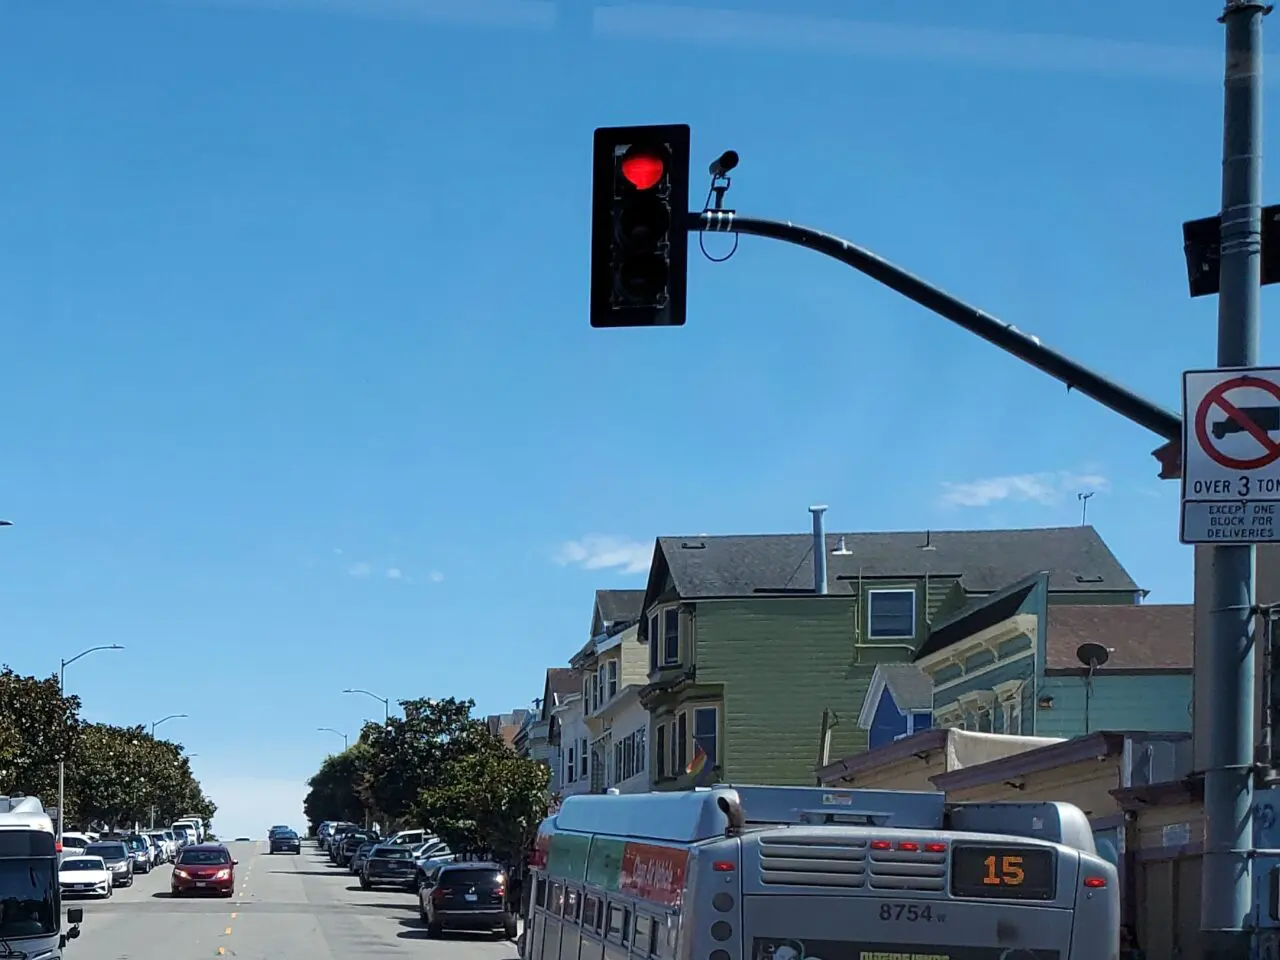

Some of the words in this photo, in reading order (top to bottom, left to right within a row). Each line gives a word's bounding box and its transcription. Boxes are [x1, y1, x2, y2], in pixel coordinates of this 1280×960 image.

[1193, 479, 1231, 494] OVER
[1237, 475, 1250, 497] 3
[1208, 504, 1246, 515] EXCEPT
[1253, 504, 1276, 514] ONE
[1210, 516, 1245, 526] BLOCK
[1252, 516, 1273, 526] FOR
[1207, 528, 1275, 538] DELIVERIES
[982, 855, 1025, 886] 15
[879, 903, 933, 922] 8754
